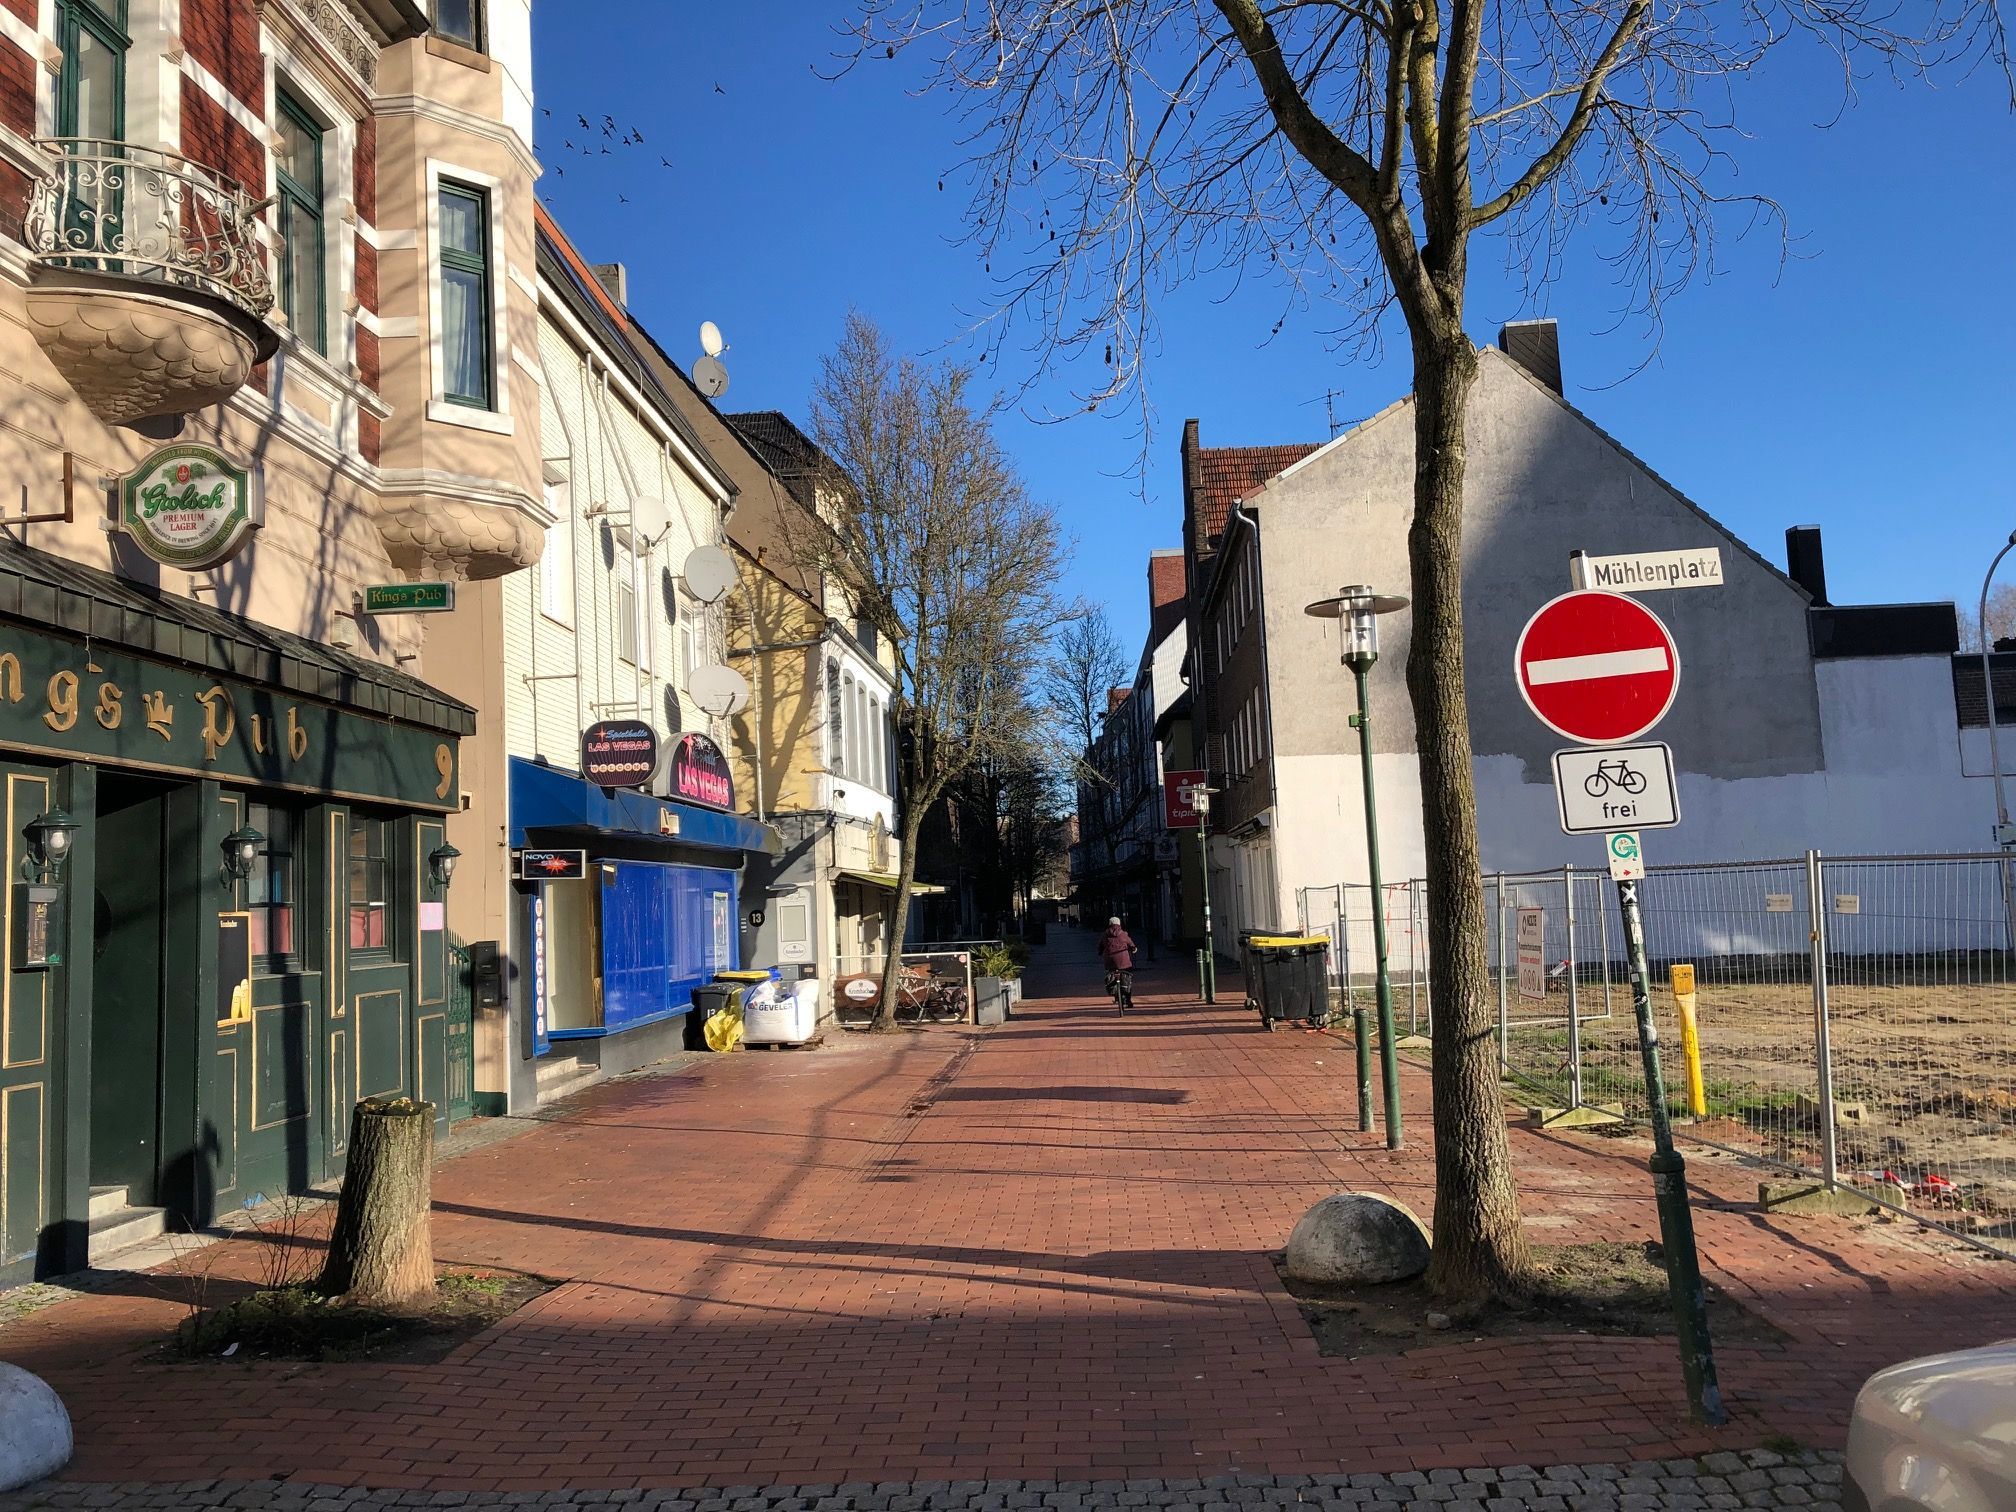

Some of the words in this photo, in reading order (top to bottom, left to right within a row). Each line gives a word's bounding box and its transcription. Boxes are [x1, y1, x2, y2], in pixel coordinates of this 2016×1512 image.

[141, 482, 226, 518] Grolsch
[163, 513, 205, 523] PREMIUM
[170, 522, 197, 531] LAGER
[1594, 557, 1719, 586] Mühlenplatz
[414, 588, 442, 604] Pub
[193, 685, 308, 762] Pub
[588, 742, 610, 752] LAS
[612, 740, 651, 751] VEGAS
[435, 744, 453, 799] 9
[591, 762, 650, 773] WELCOME
[678, 762, 698, 796] LAS
[698, 770, 729, 806] VEGAS
[1602, 800, 1637, 819] frei
[751, 913, 762, 924] 13
